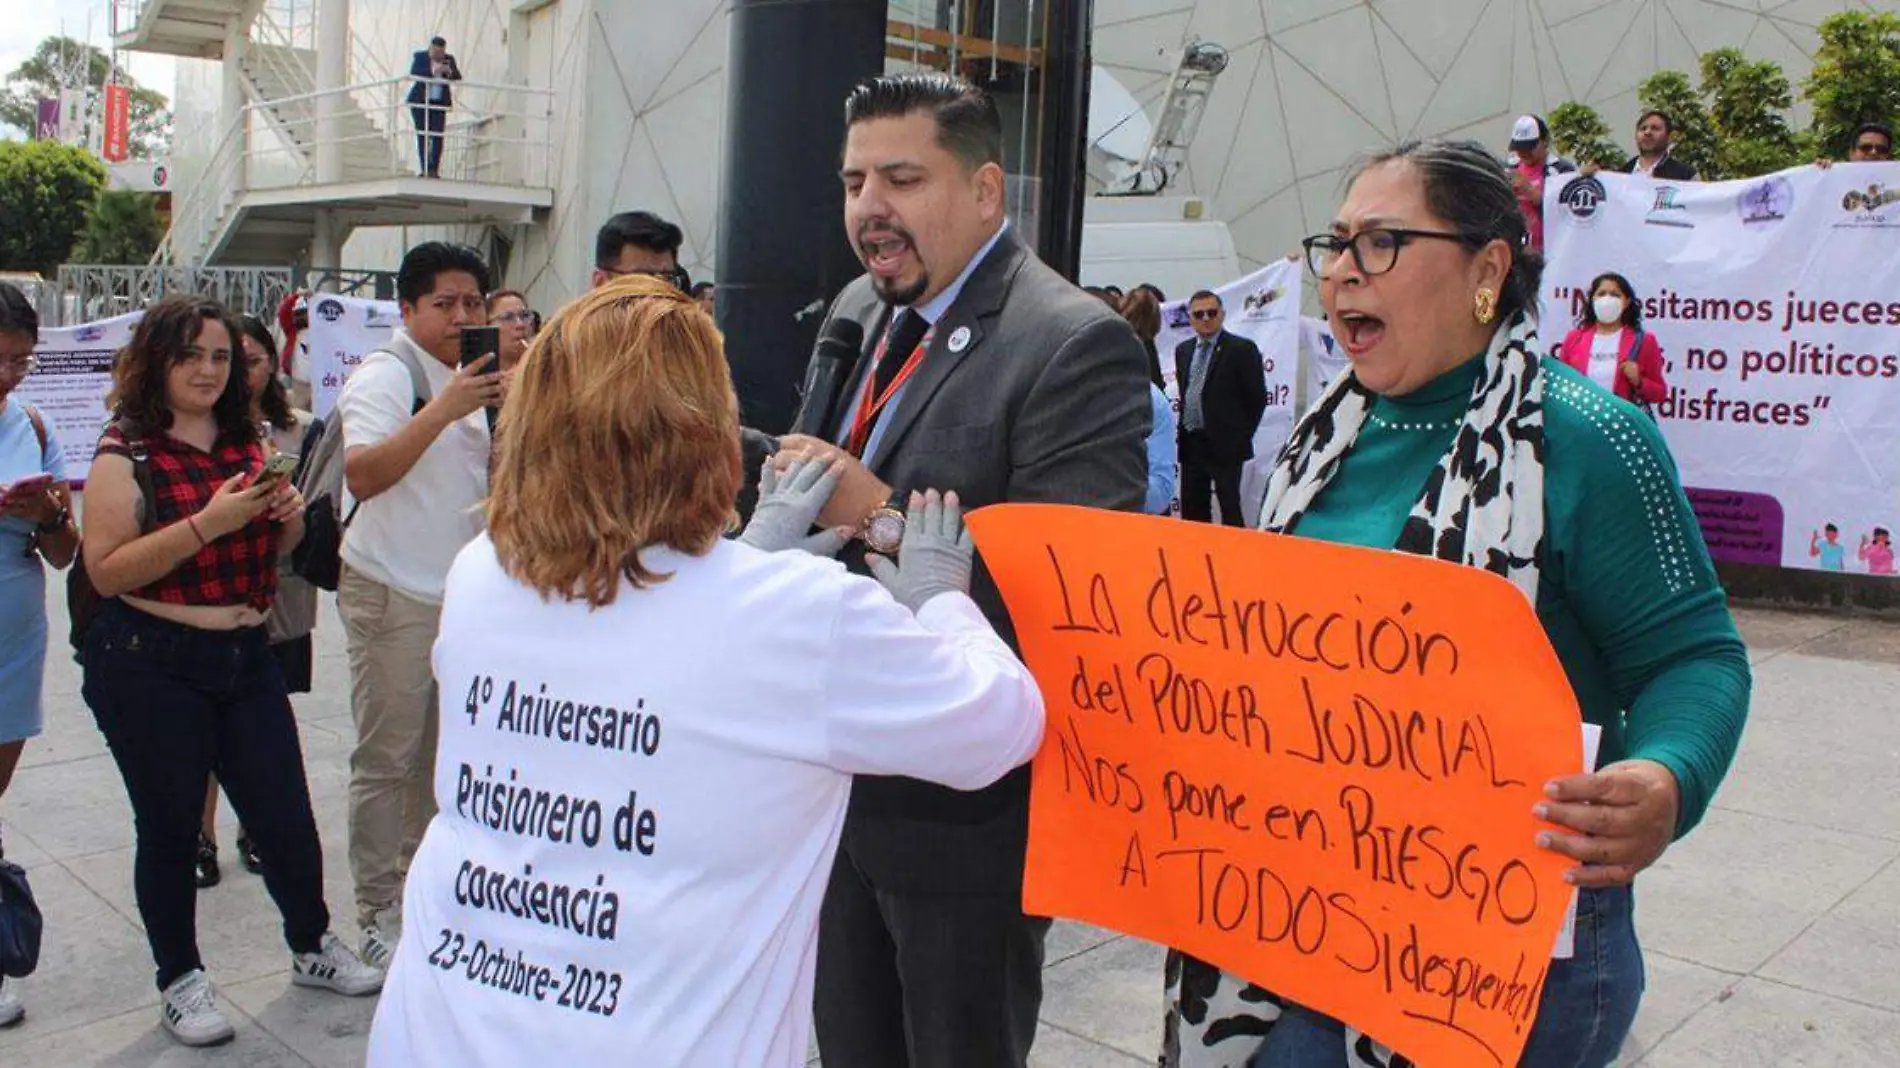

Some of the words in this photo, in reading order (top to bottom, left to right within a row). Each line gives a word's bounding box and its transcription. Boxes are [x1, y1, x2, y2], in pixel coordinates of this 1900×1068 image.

[1554, 287, 1774, 322] "Nsitamos
[1781, 290, 1900, 332] jueces
[1687, 348, 1728, 371] no
[1741, 340, 1898, 381] políticos
[1047, 544, 1121, 637] La
[1147, 546, 1459, 676] detrucción
[497, 680, 661, 757] Aniversario
[1072, 655, 1133, 724] del
[1136, 653, 1271, 755] PODER
[1285, 676, 1527, 787] JUDICIAL
[457, 763, 602, 848] Prisionero
[613, 790, 656, 856] de
[1163, 770, 1250, 841] pone
[1339, 785, 1538, 924] RIESGO
[455, 860, 619, 941] conciencia
[1119, 830, 1148, 888] A
[1156, 848, 1380, 973] TODOS
[428, 928, 622, 1016] 23-Octubre-2023
